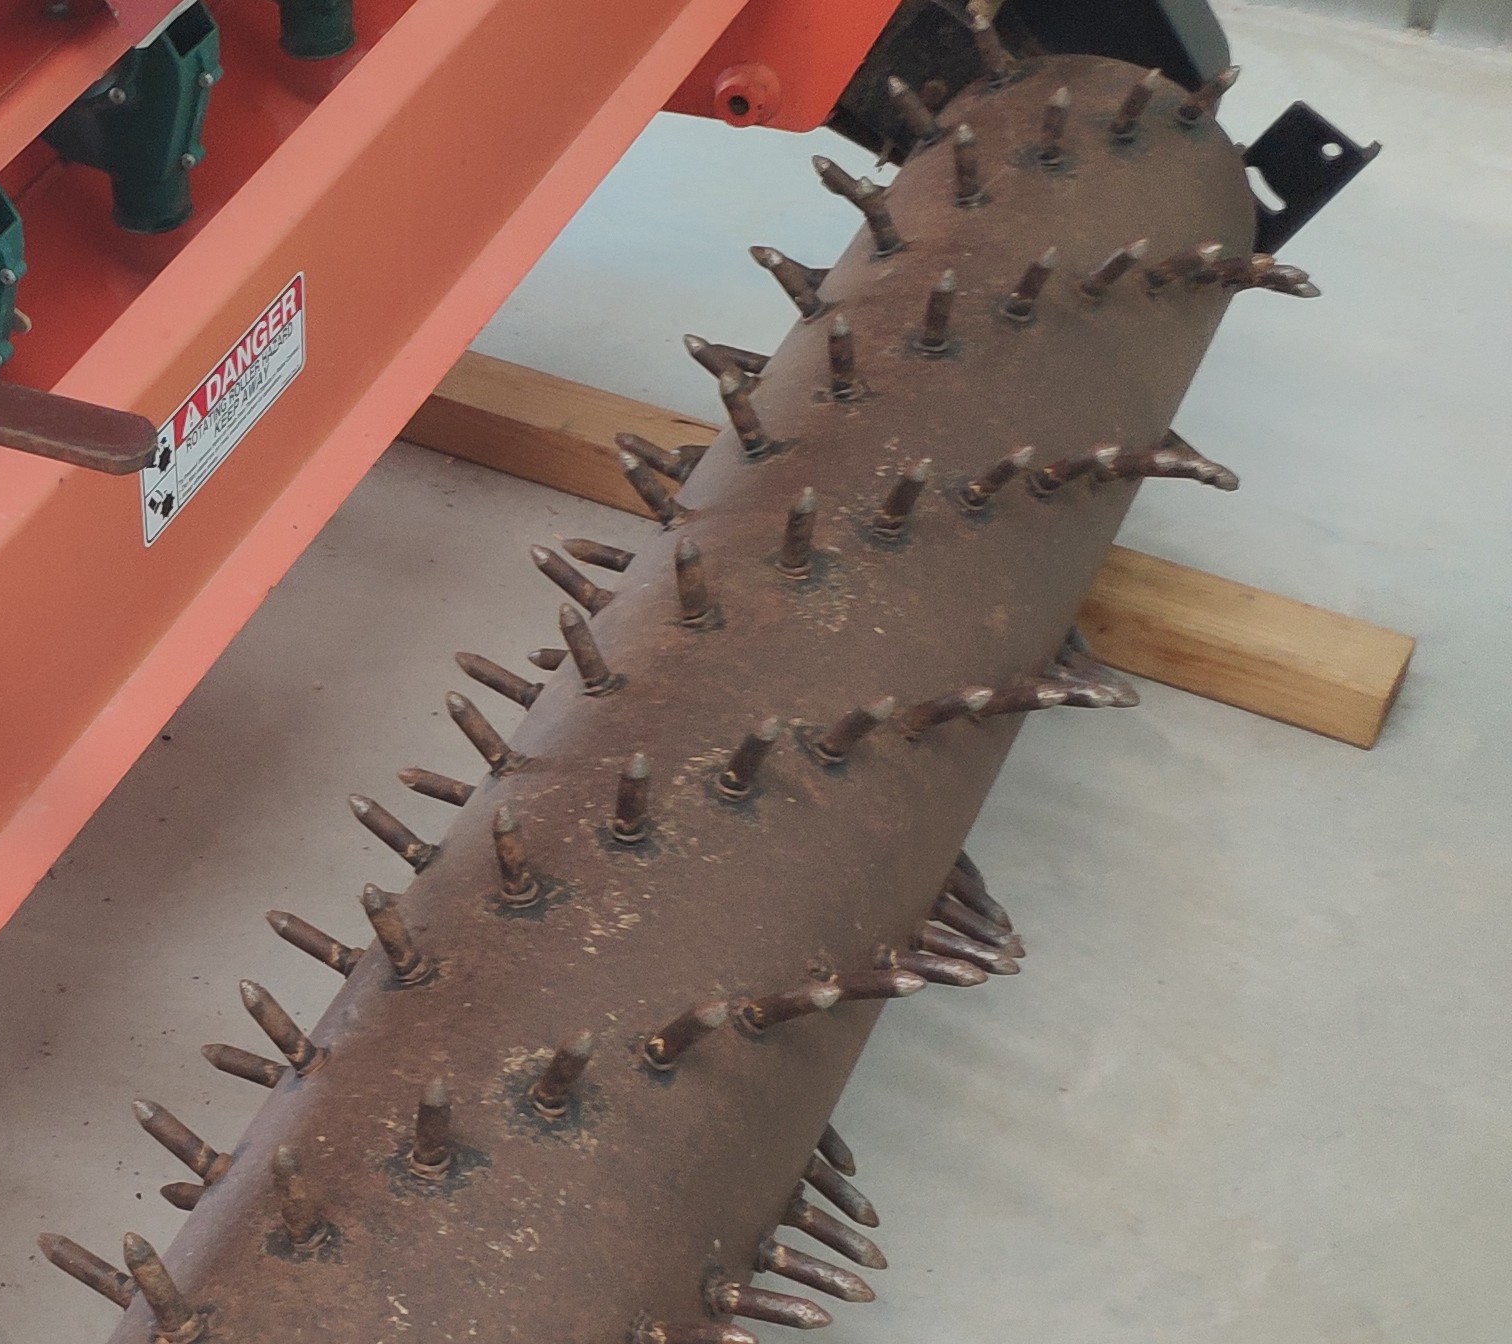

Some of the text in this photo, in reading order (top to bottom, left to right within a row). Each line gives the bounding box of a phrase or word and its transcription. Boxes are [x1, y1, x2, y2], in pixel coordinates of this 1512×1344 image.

[185, 397, 227, 453] ROTATING
[228, 359, 260, 404] ROLLER
[261, 321, 293, 366] HAZARD
[205, 286, 297, 411] DANGER
[214, 364, 270, 437] KEEP AWAY
